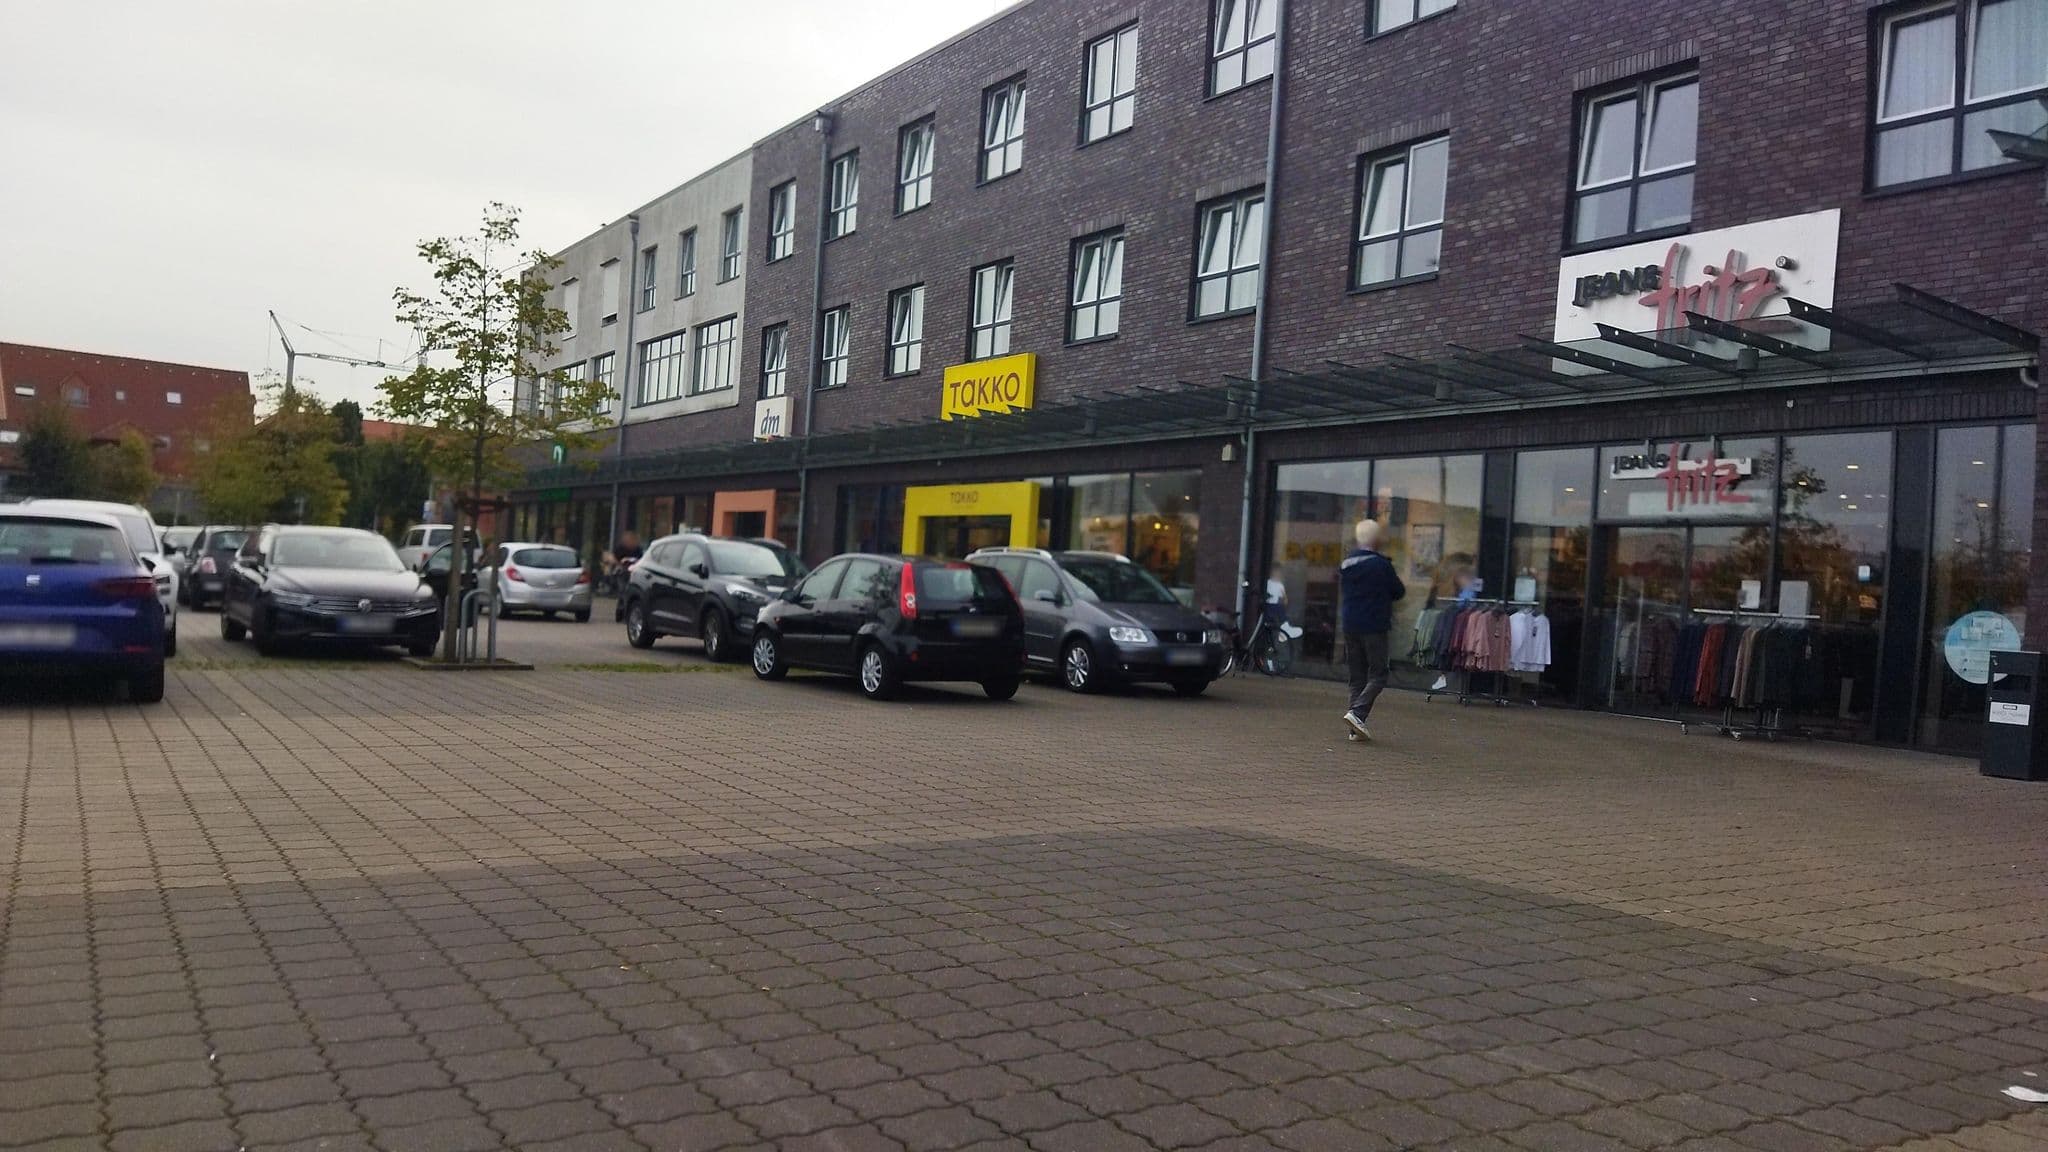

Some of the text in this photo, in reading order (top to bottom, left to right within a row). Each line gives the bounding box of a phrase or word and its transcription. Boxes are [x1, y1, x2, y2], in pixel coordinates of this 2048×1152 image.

[1572, 242, 1790, 340] JEANS fritz
[760, 407, 780, 435] dm
[1613, 441, 1752, 512] JEANS fritz
